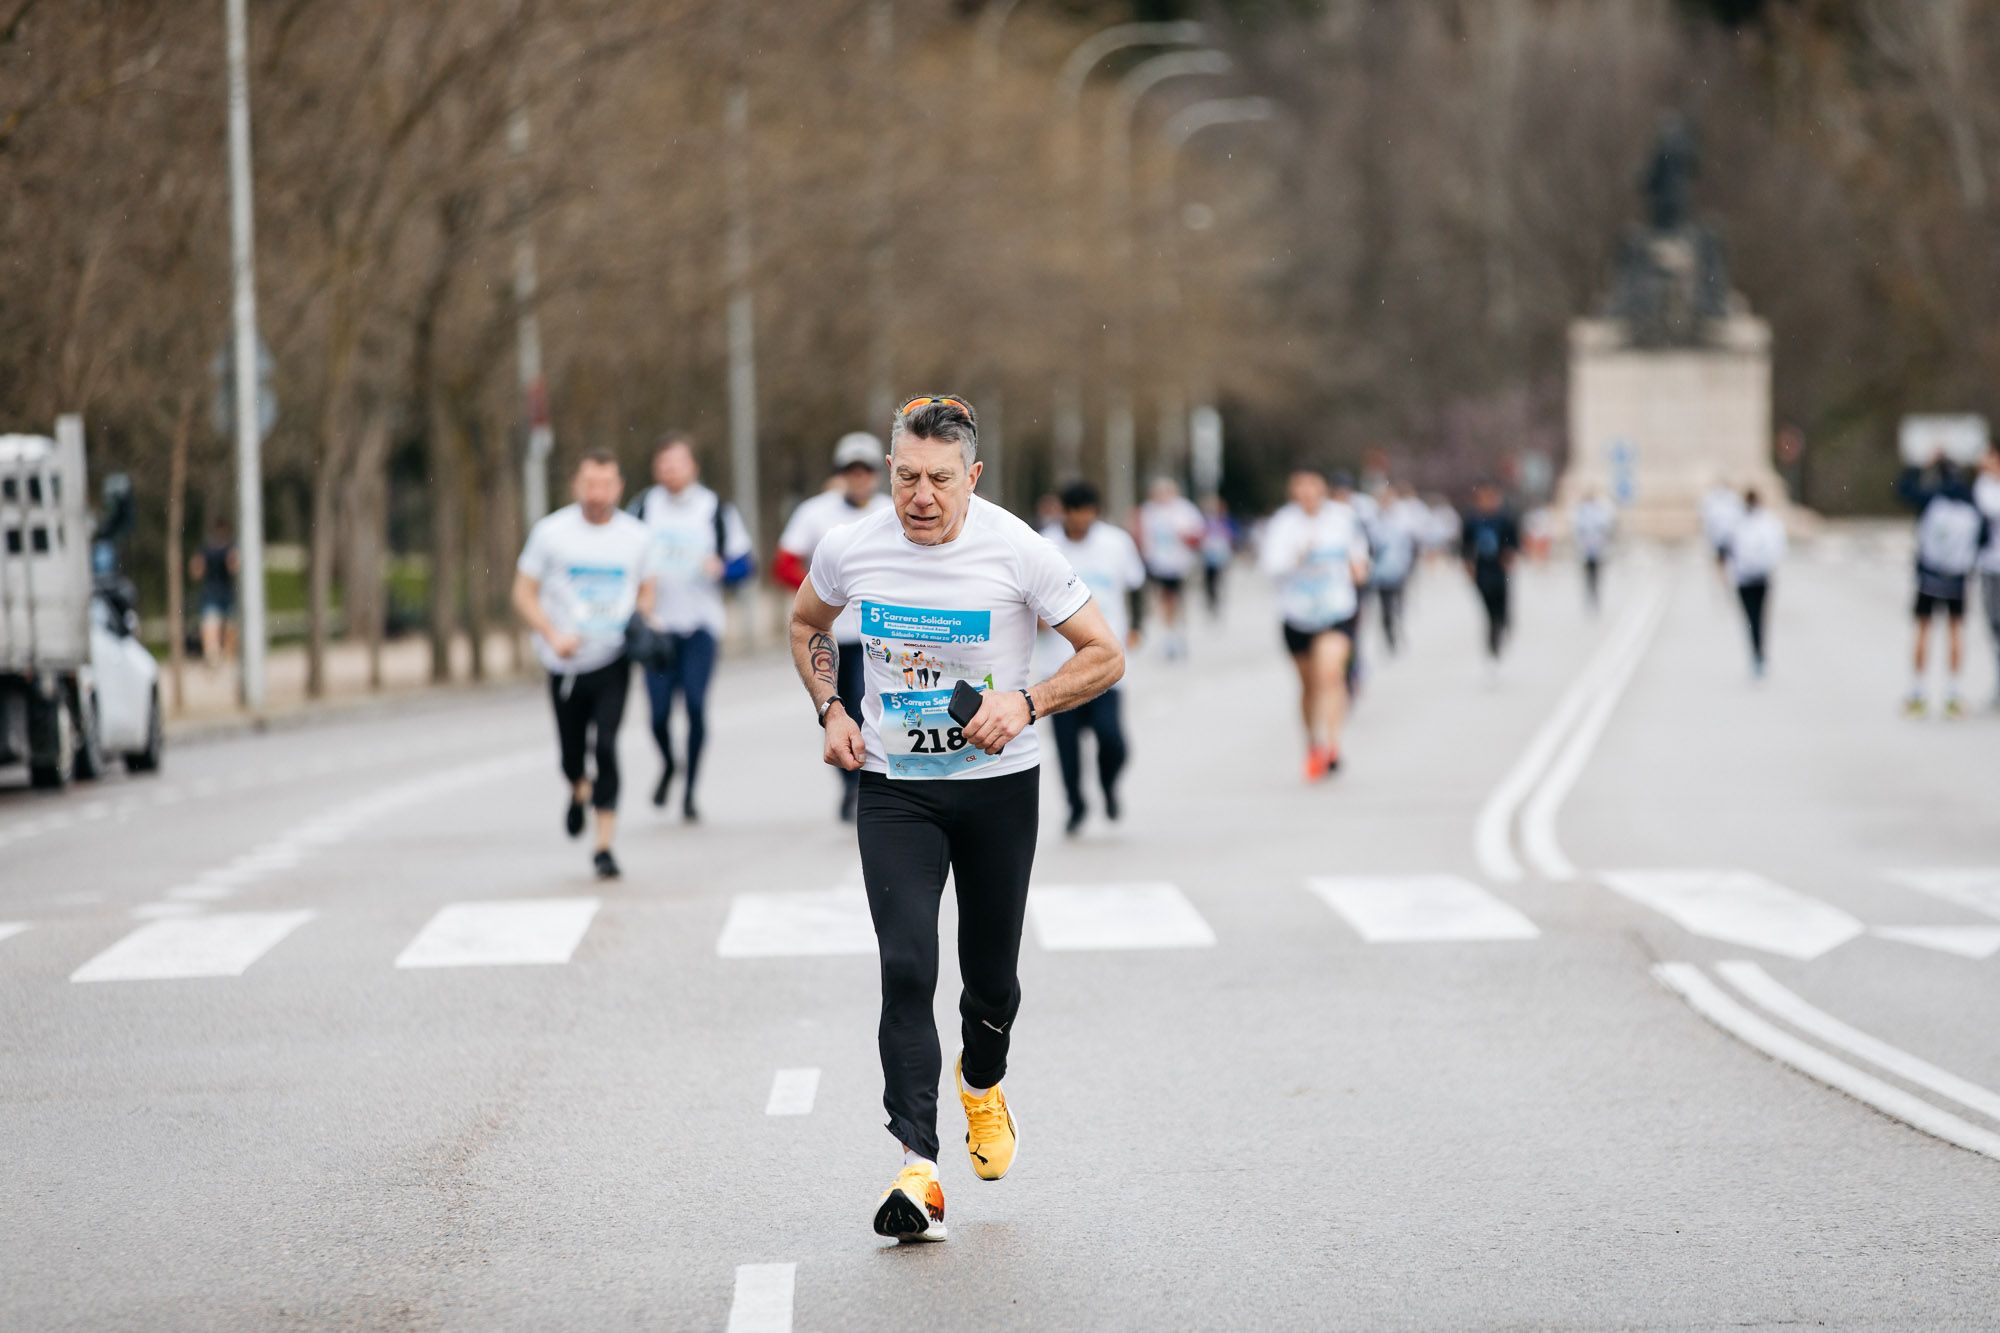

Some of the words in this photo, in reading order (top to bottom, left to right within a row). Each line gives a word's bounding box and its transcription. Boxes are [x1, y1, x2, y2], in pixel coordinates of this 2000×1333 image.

[883, 611, 918, 623] Carrera
[920, 615, 961, 626] Solidaria
[915, 631, 919, 639] 7
[951, 633, 985, 644] 2026
[902, 698, 931, 706] Carrera
[908, 727, 968, 753] 218
